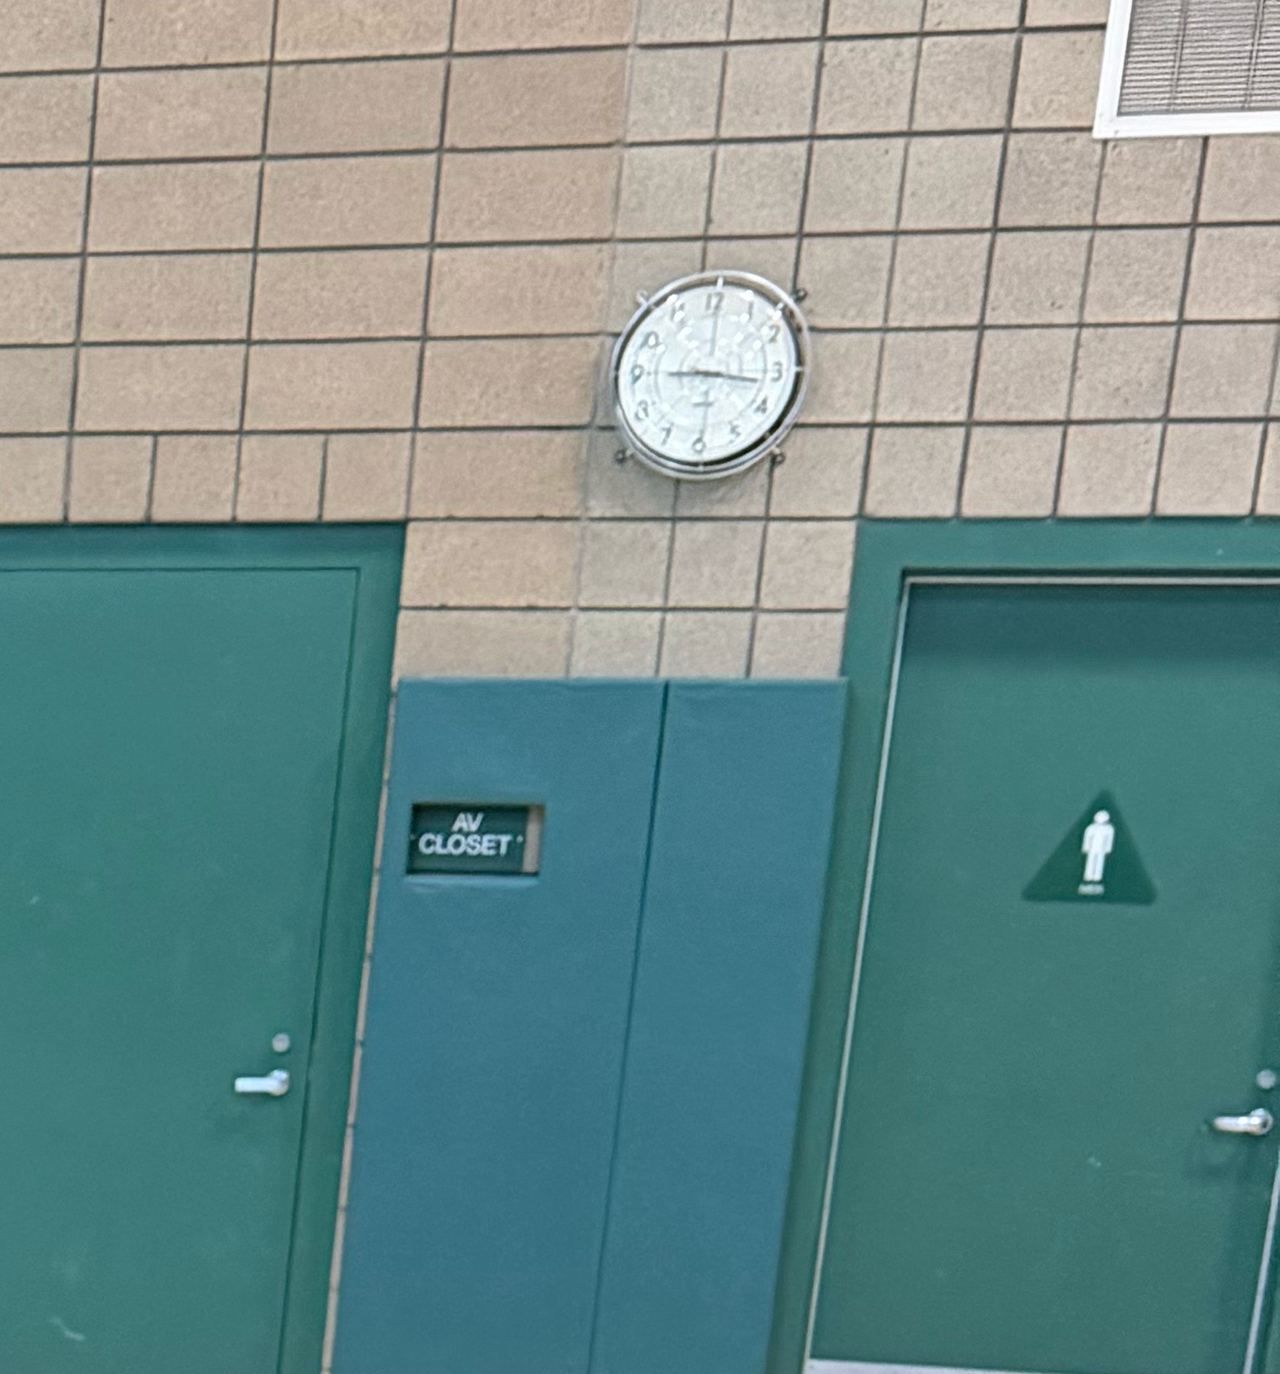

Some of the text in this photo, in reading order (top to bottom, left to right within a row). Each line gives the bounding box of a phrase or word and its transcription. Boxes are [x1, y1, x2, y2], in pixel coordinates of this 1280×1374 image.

[767, 324, 781, 344] 2
[771, 361, 783, 382] 3
[451, 812, 484, 832] AV
[418, 832, 514, 857] CLOSET
